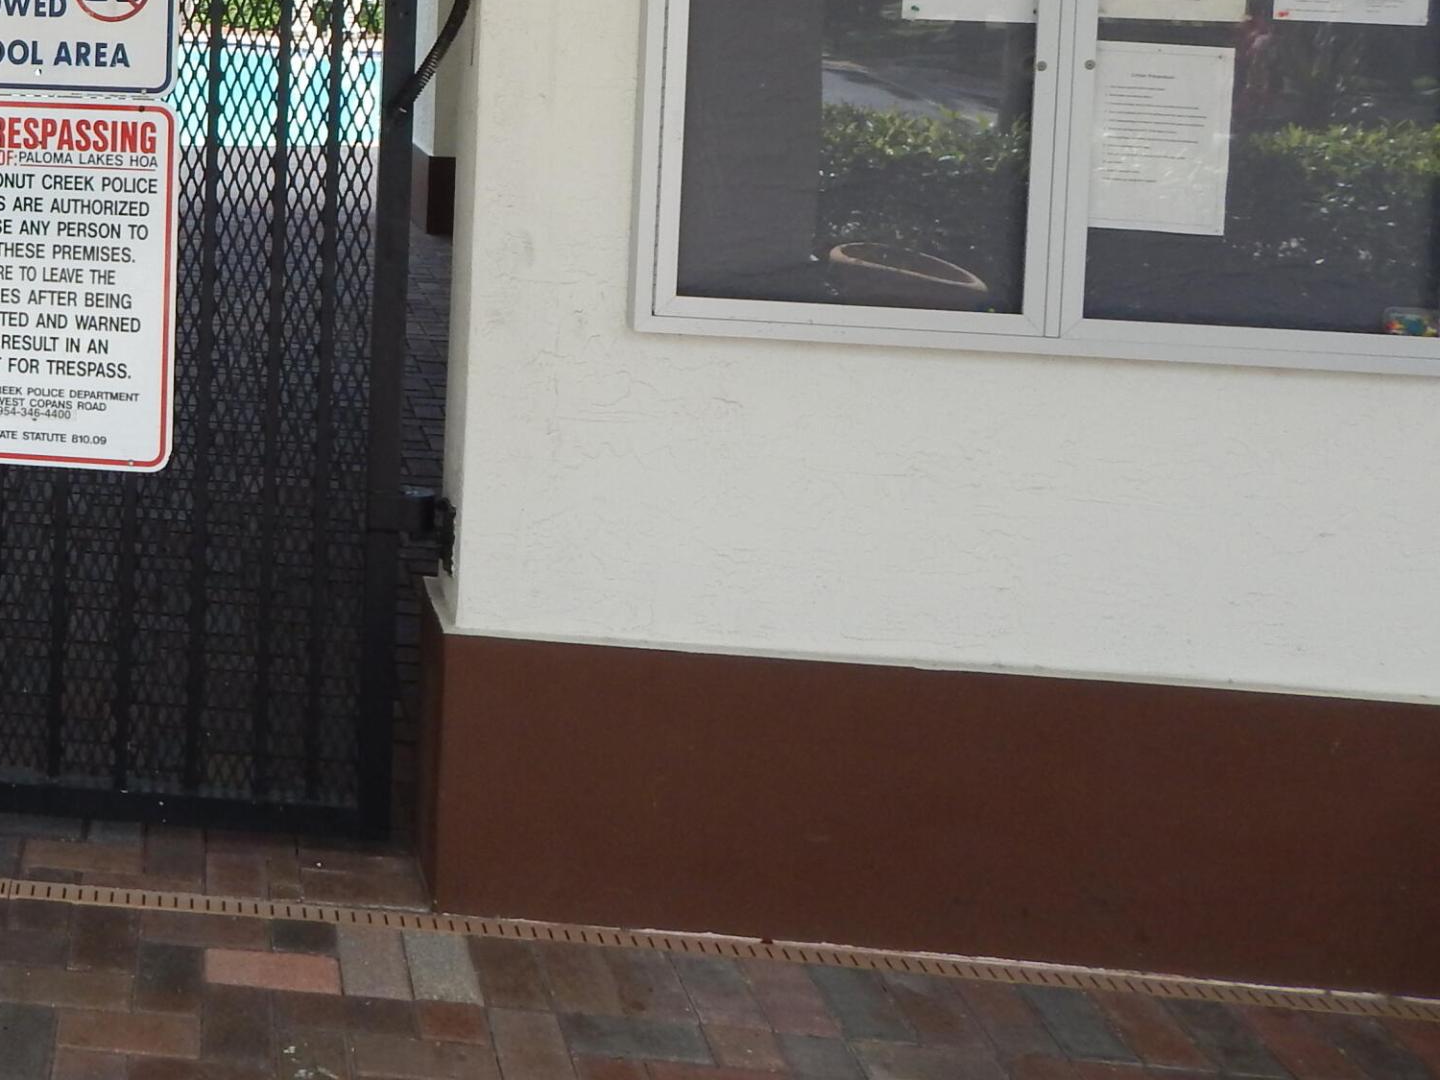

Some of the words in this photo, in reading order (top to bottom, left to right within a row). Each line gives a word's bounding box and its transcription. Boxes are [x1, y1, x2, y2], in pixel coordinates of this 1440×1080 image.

[54, 42, 130, 68] AREA
[19, 152, 72, 165] PALOMA
[79, 153, 123, 166] LAKES
[130, 155, 157, 167] HOA
[42, 174, 94, 191] CREEK
[102, 177, 157, 194] POLICE
[13, 197, 43, 212] ARE
[50, 199, 149, 216] AUTHORIZED
[19, 220, 50, 236] ANY
[57, 222, 120, 239] PERSON
[128, 225, 148, 240] TO
[52, 245, 135, 263] PREMISES.
[19, 266, 37, 281] TO
[43, 267, 83, 283] LEAVE
[90, 270, 115, 285] THE
[28, 290, 77, 306] AFTER
[85, 292, 131, 309] BEING
[36, 313, 67, 329] AND
[76, 316, 140, 332] WARNED
[1, 334, 59, 352] RESULT
[66, 338, 80, 352] IN
[87, 339, 108, 354] AN
[9, 358, 39, 374] FOR
[46, 360, 131, 379] TRESPASS.
[27, 387, 64, 398] POLICE
[69, 390, 140, 402] DEPARTMENT
[30, 399, 72, 410] COPANS
[77, 402, 106, 411] ROAD
[23, 432, 66, 443] STATUTE
[72, 434, 107, 445] 810.09
